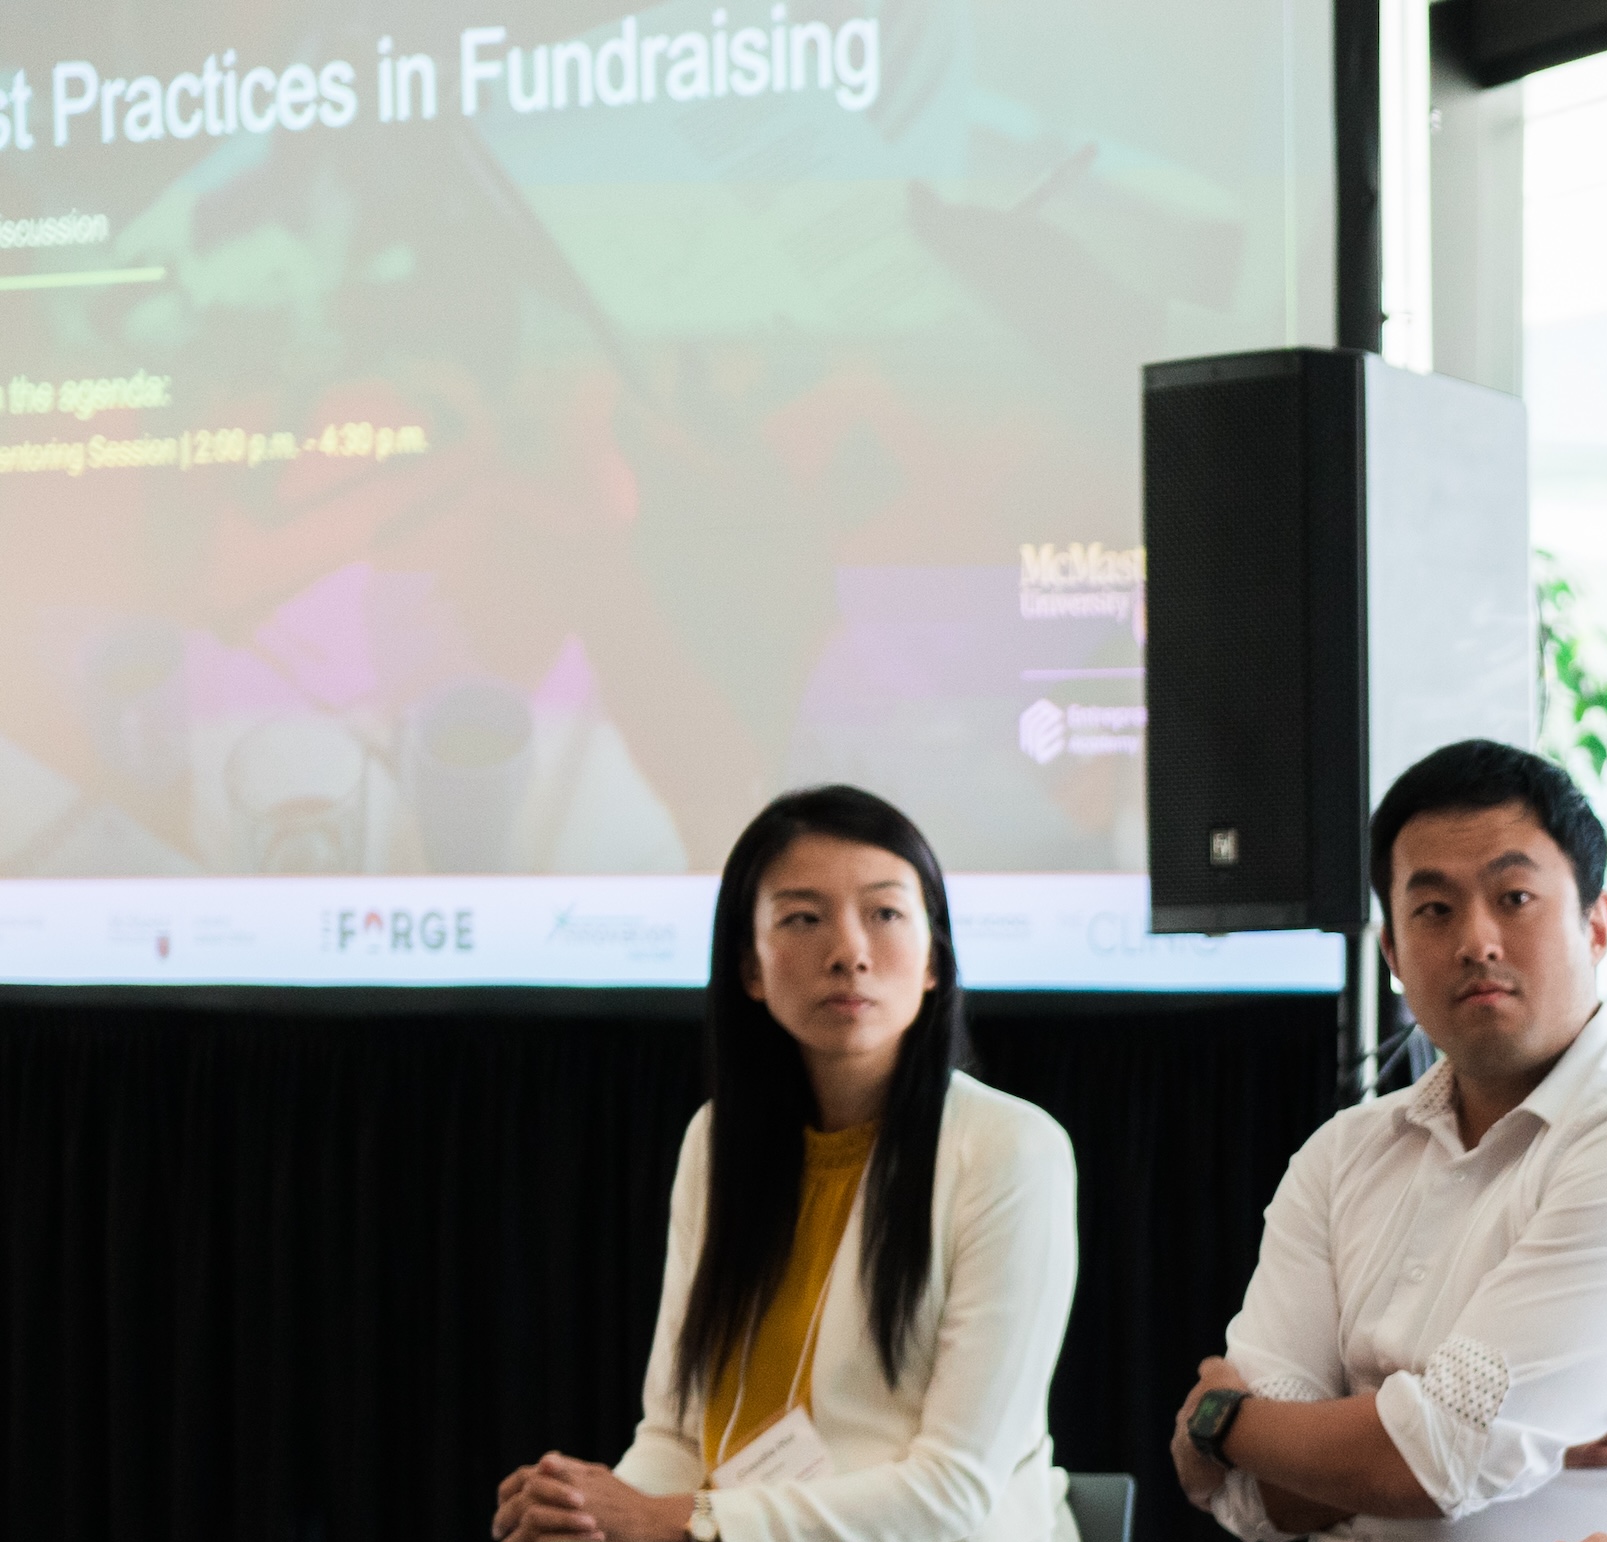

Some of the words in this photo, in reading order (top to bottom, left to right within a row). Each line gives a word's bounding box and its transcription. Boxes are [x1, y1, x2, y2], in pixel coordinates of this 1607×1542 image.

[53, 48, 358, 147] Practices
[377, 35, 437, 123] in
[460, 3, 880, 117] Fundraising
[0, 207, 109, 249] scussion
[57, 369, 171, 420] agenda:
[0, 437, 85, 476] entoring
[87, 434, 178, 468] Session
[1020, 541, 1147, 585] McMast
